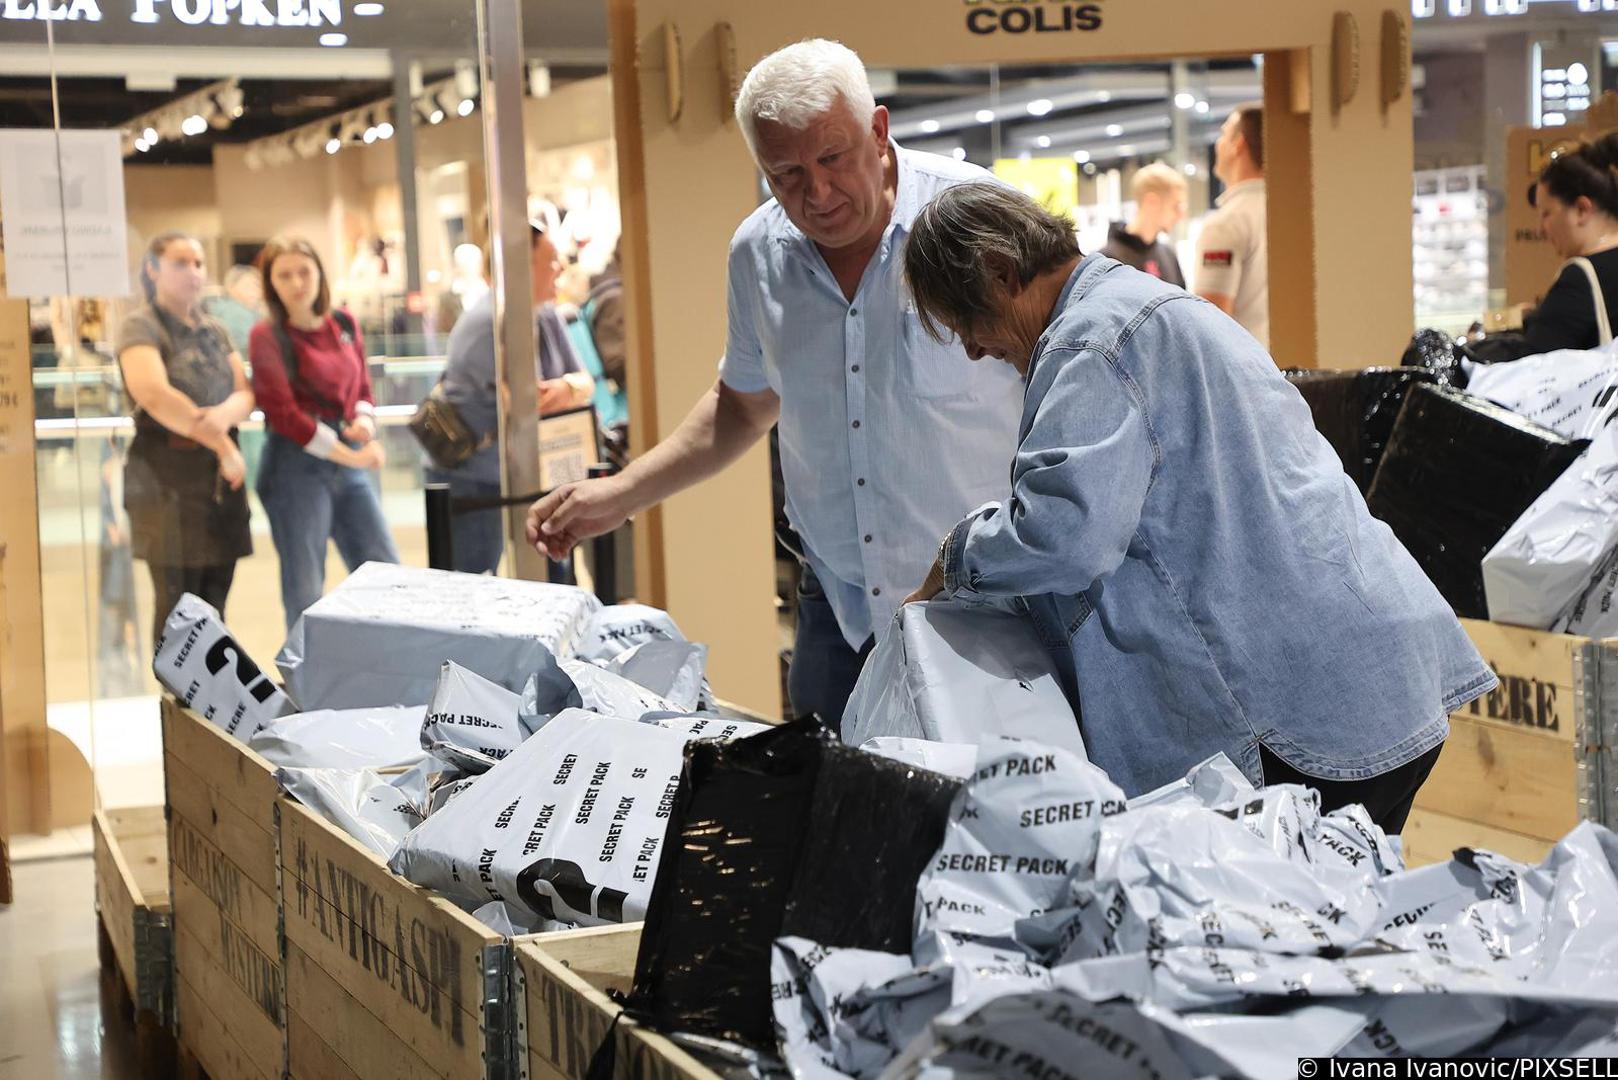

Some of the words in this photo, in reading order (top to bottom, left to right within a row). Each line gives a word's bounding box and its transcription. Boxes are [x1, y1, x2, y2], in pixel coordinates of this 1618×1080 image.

[966, 5, 1103, 35] COLIS
[173, 630, 199, 669] SECRET
[553, 753, 578, 785] SECRET
[631, 767, 648, 779] SE
[1005, 755, 1057, 777] PACK
[575, 787, 600, 825] SECRET
[590, 761, 612, 786] PACK
[655, 783, 678, 819] SECRET
[533, 803, 556, 830] PACK
[1020, 800, 1095, 828] SECRET
[599, 823, 624, 863] SECRET
[613, 796, 636, 821] PACK
[637, 837, 660, 862] PACK
[478, 848, 497, 883] PACK
[632, 864, 649, 883] ET
[936, 854, 1011, 872] SECRET
[1016, 856, 1069, 876] PACK
[937, 896, 986, 916] PACK
[296, 835, 464, 1048] #ANTIGASPI
